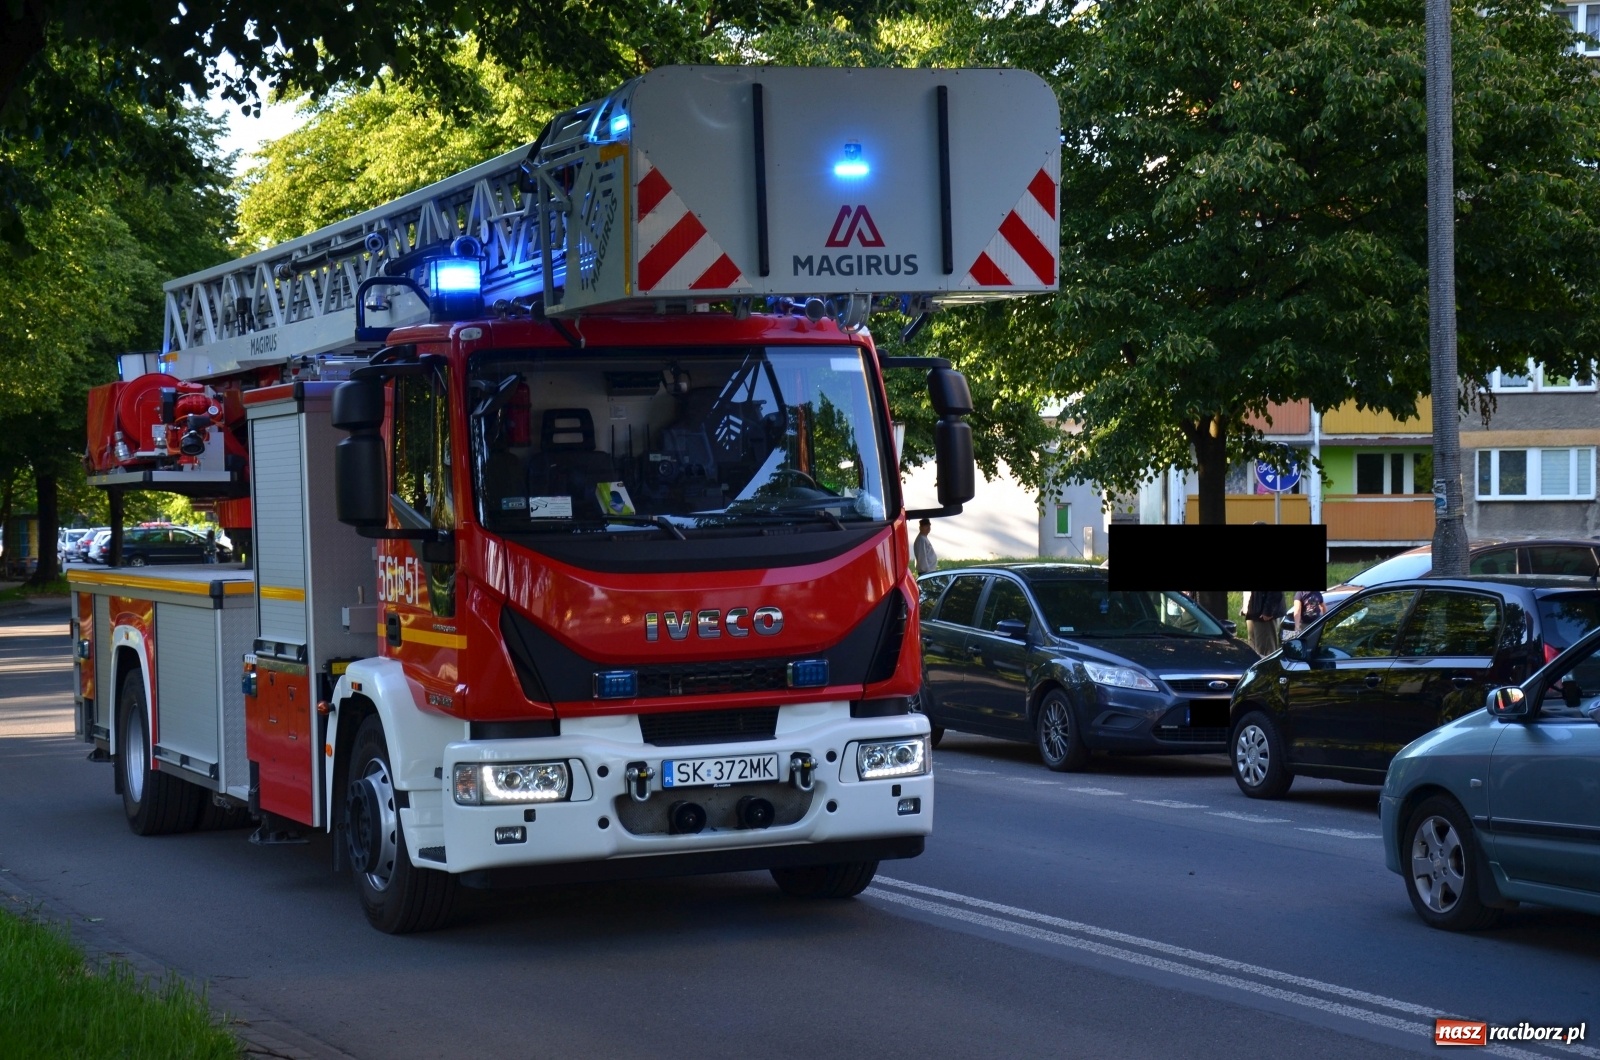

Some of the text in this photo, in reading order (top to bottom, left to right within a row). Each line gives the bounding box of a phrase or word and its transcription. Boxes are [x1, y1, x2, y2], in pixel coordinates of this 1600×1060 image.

[590, 192, 618, 292] MAGIRUS
[792, 254, 919, 276] MAGIRUS
[250, 333, 277, 356] MAGIRUS
[645, 606, 784, 642] IVECO
[677, 757, 774, 783] SK 372MK
